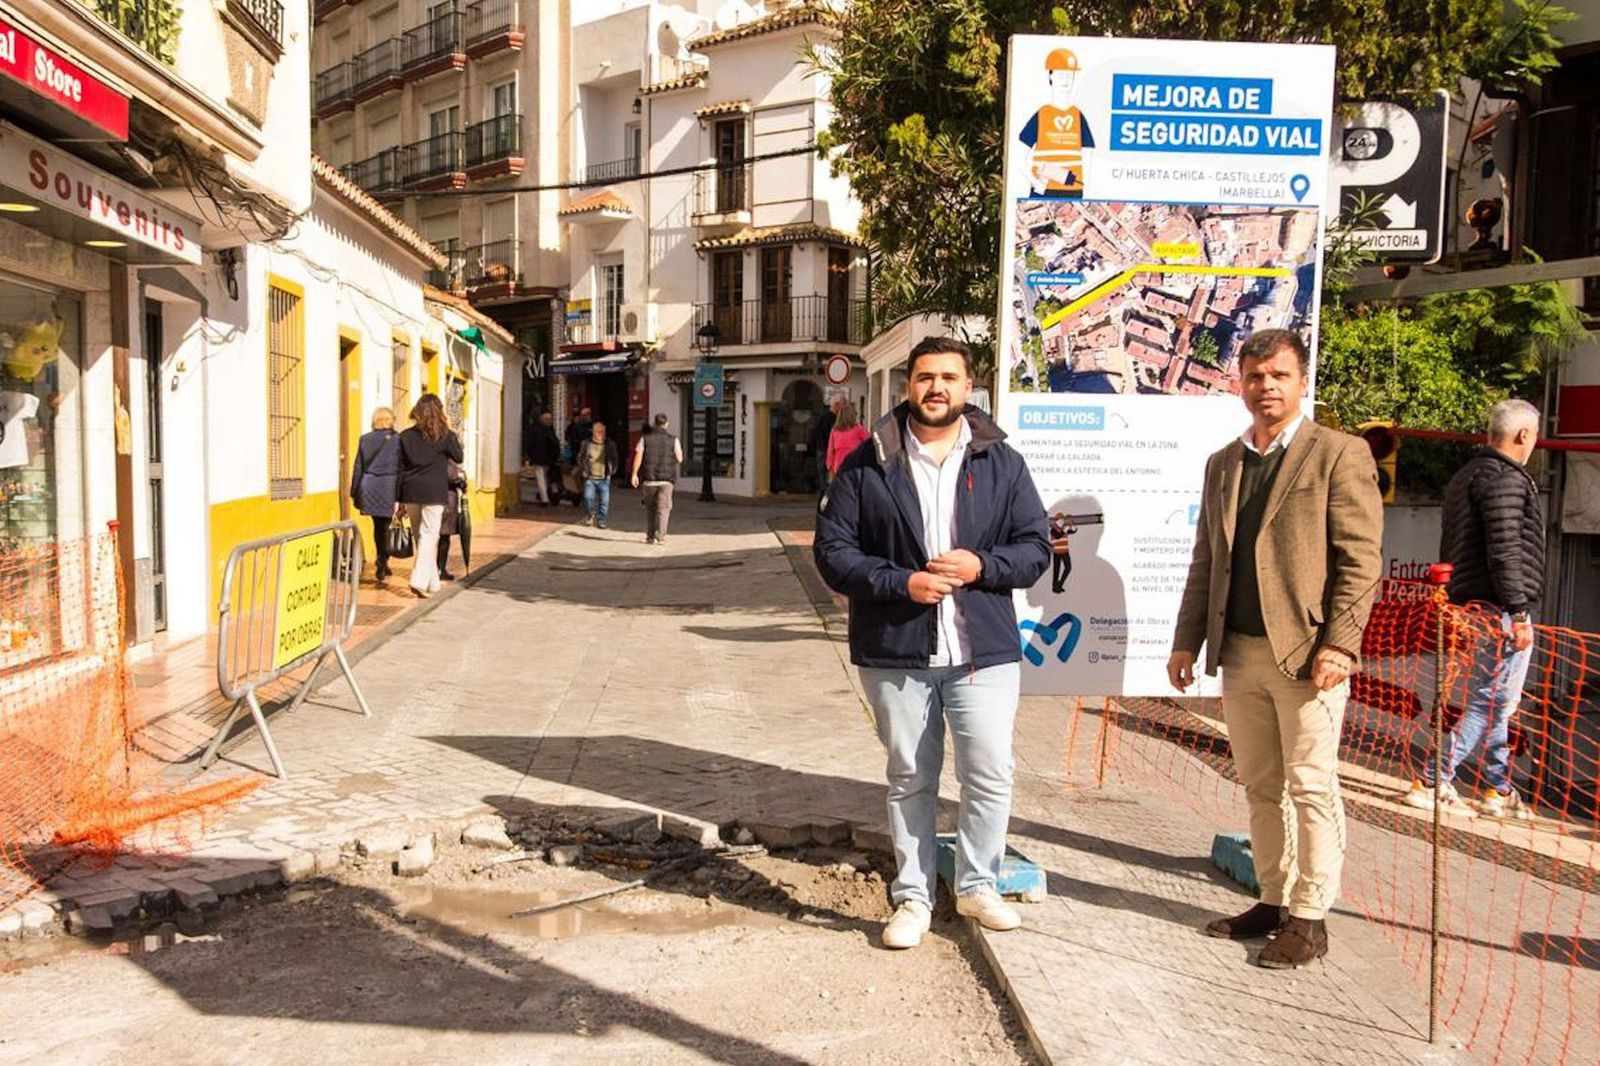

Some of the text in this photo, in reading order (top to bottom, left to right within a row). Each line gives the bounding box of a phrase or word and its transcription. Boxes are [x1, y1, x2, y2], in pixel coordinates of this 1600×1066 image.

[35, 47, 82, 103] Store
[1122, 84, 1261, 110] MEJORA DE
[1119, 120, 1319, 149] SEGURIDAD VIAL
[1126, 169, 1170, 181] HUERTA
[1172, 170, 1205, 181] CHICA
[1215, 171, 1286, 184] CASTILLEJOS
[28, 149, 184, 251] Souvenirs
[1367, 234, 1421, 248] VICTORIA
[1022, 411, 1101, 426] OBJETIVOS:
[297, 543, 320, 571] CALLE
[286, 582, 322, 613] CORTADA
[279, 616, 322, 653] POR OBRAS
